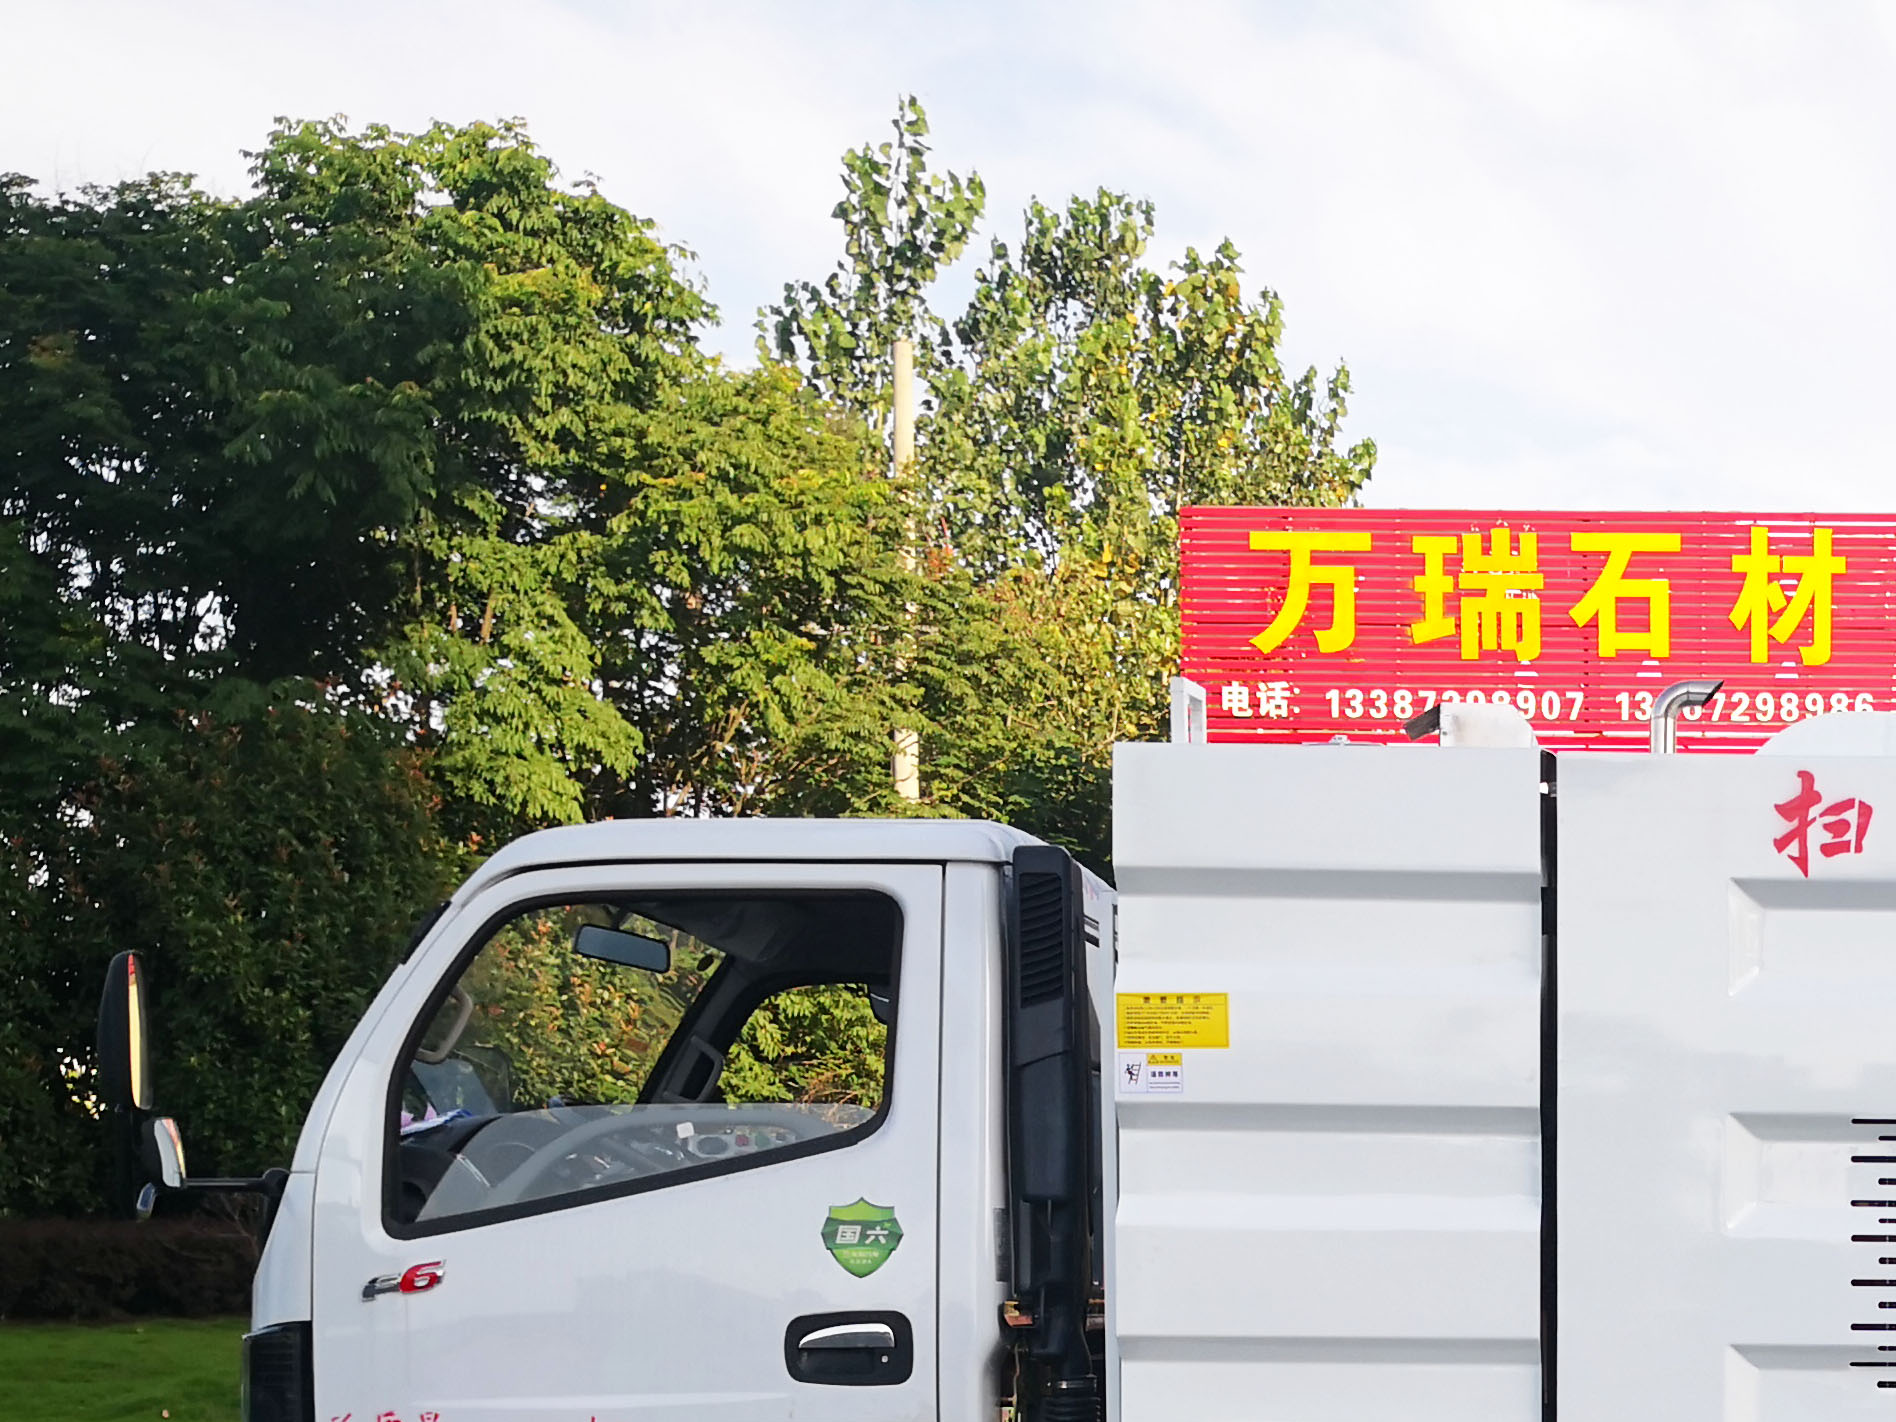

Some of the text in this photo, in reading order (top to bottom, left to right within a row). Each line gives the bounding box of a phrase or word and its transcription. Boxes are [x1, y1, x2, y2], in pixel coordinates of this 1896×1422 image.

[1249, 526, 1847, 666] 万瑞石材
[1221, 681, 1300, 718] 电话:
[1615, 690, 1875, 721] 137298986
[836, 1224, 889, 1244] 国六
